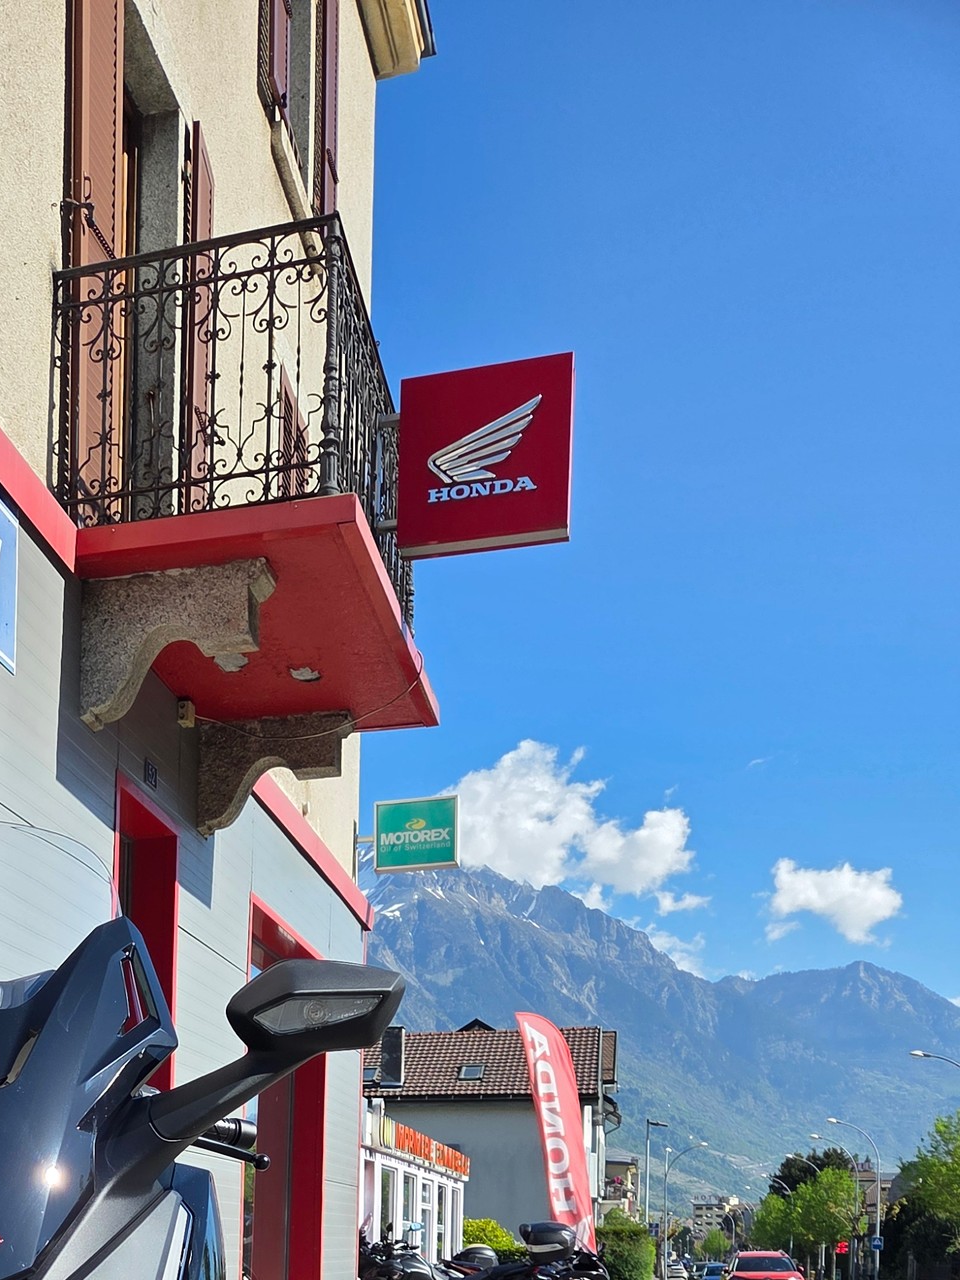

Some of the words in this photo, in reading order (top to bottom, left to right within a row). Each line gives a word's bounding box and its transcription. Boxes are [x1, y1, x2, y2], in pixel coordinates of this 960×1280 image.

[427, 476, 537, 503] HONDA
[380, 828, 450, 846] MOTOREX
[405, 841, 450, 851] Switzerland
